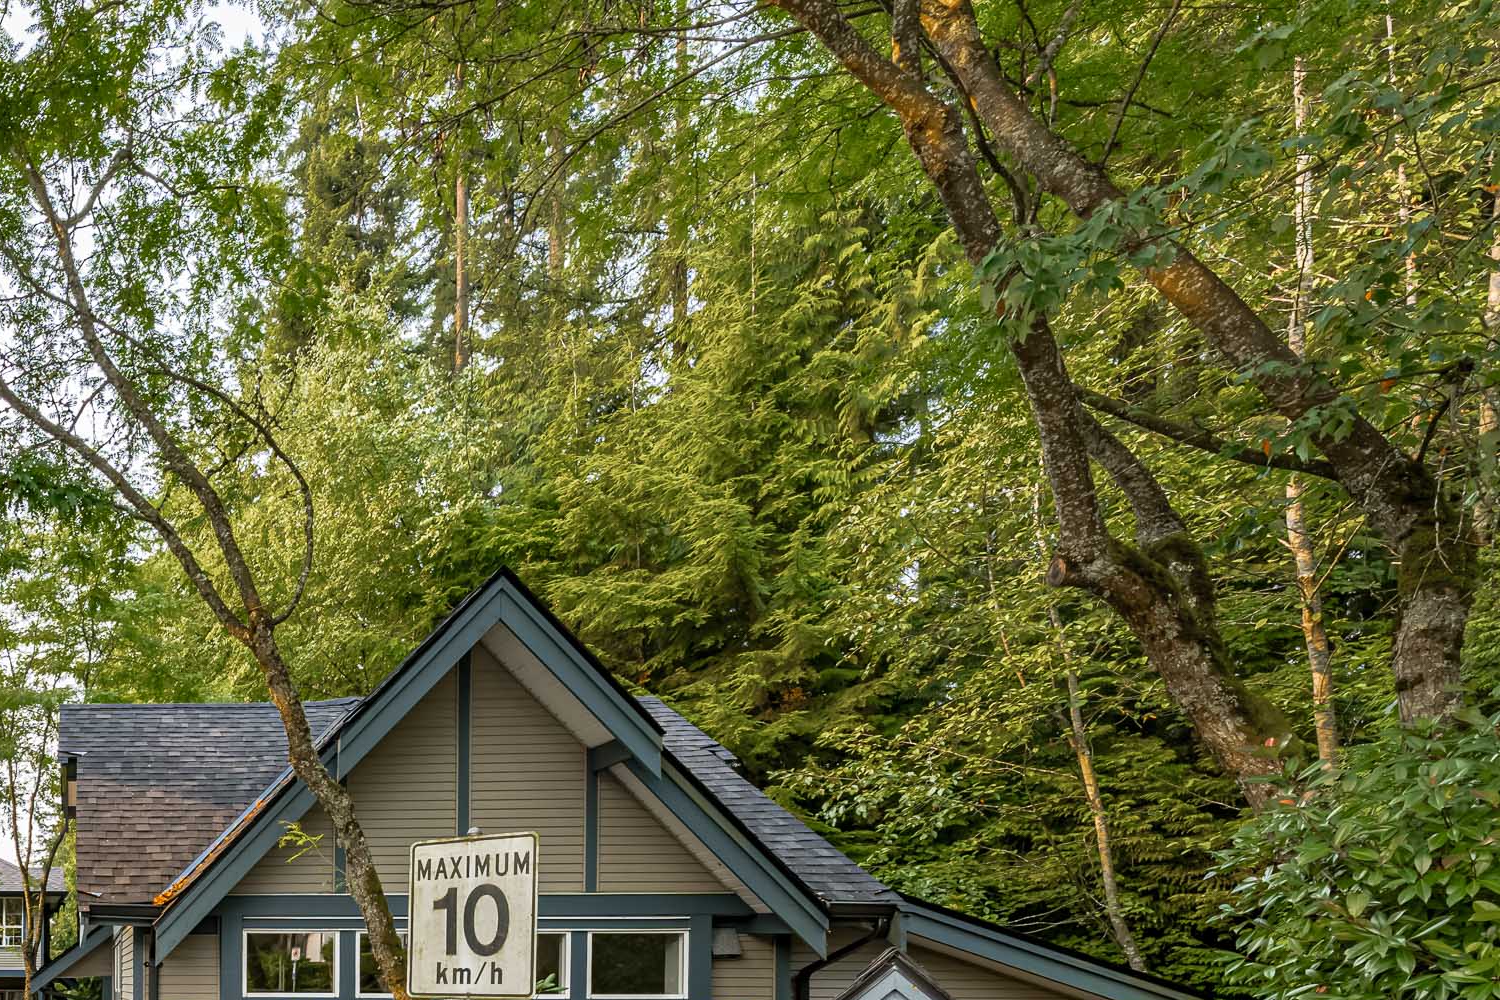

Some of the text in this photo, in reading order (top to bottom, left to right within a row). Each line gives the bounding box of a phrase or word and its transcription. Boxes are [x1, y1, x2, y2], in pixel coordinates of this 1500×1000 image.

[417, 851, 530, 881] MAXIMUM
[433, 883, 510, 957] 10
[435, 961, 503, 985] km/h
